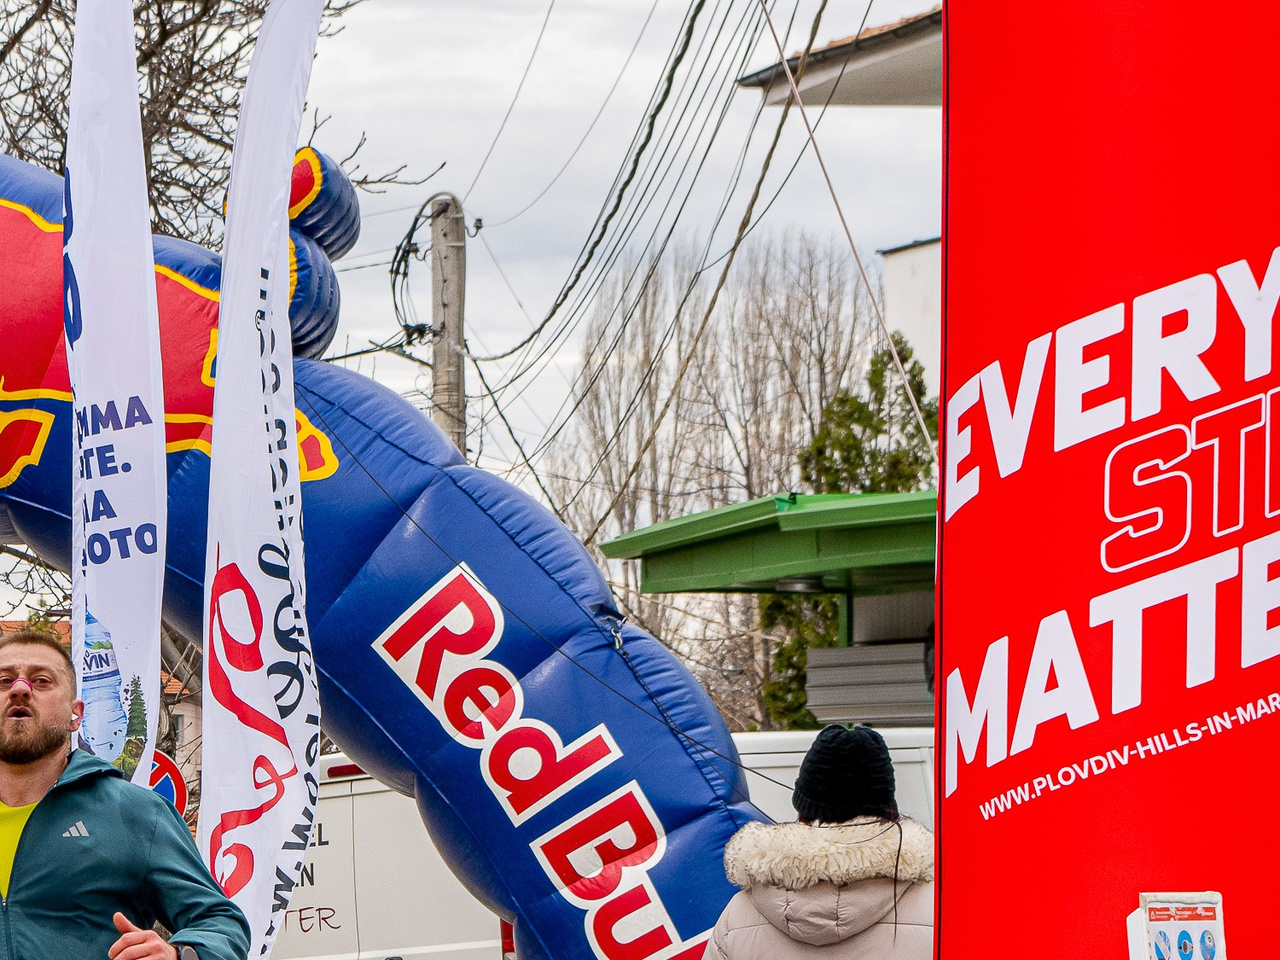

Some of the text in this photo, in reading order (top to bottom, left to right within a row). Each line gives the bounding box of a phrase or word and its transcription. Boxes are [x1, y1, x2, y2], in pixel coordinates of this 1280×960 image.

[946, 246, 1280, 523] EVERY
[1101, 388, 1280, 573] ST
[83, 523, 157, 566] ОТО
[382, 573, 612, 816] Red
